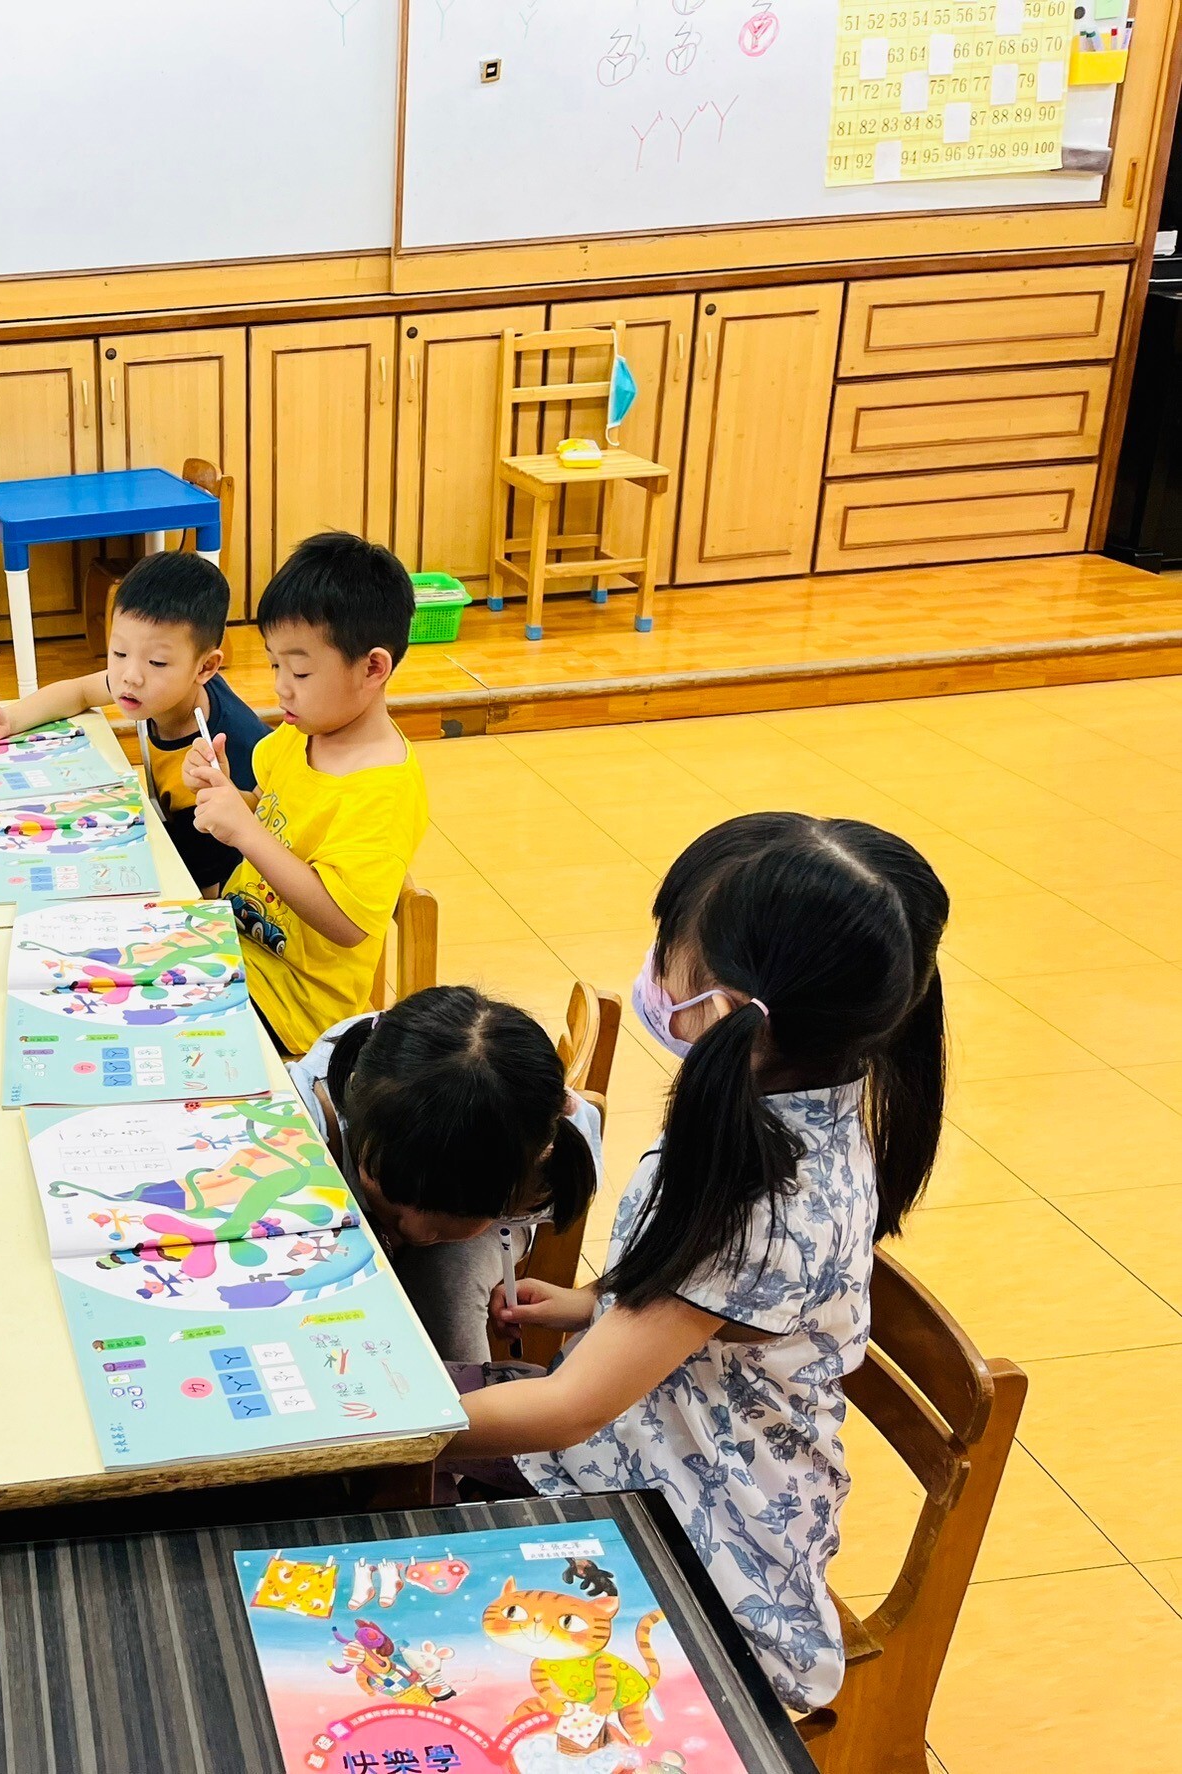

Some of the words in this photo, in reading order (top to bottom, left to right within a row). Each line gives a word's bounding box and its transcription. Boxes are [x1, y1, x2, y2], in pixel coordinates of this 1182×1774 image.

[845, 15, 860, 31] 51
[867, 14, 884, 29] 52
[889, 12, 906, 28] 53
[912, 11, 928, 27] 54
[934, 9, 950, 25] 55
[956, 8, 973, 23] 56
[979, 6, 996, 21] 57
[1048, 1, 1065, 16] 60
[843, 52, 857, 66] 61
[888, 47, 904, 63] 63
[910, 46, 926, 61] 64
[953, 43, 970, 58] 66
[976, 41, 993, 56] 67
[999, 39, 1015, 55] 68
[1021, 38, 1038, 53] 69
[1046, 36, 1062, 51] 70
[840, 86, 853, 101] 71
[863, 84, 879, 99] 72
[885, 82, 902, 97] 73
[930, 80, 945, 95] 75
[952, 78, 967, 93] 76
[974, 76, 990, 91] 77
[1018, 73, 1035, 88] 79
[837, 121, 852, 136] 81
[859, 120, 876, 134] 82
[881, 118, 898, 133] 83
[903, 116, 919, 131] 84
[925, 114, 942, 129] 85
[970, 111, 986, 126] 87
[992, 109, 1008, 124] 88
[1014, 108, 1031, 122] 89
[1038, 106, 1055, 121] 90
[833, 155, 849, 170] 91
[856, 154, 872, 169] 92
[901, 151, 917, 165] 94
[923, 149, 939, 163] 95
[945, 147, 961, 161] 96
[968, 145, 984, 160] 97
[990, 143, 1006, 158] 98
[1012, 142, 1029, 156] 99
[1035, 142, 1054, 154] 100
[342, 1744, 462, 1774] 快樂學
